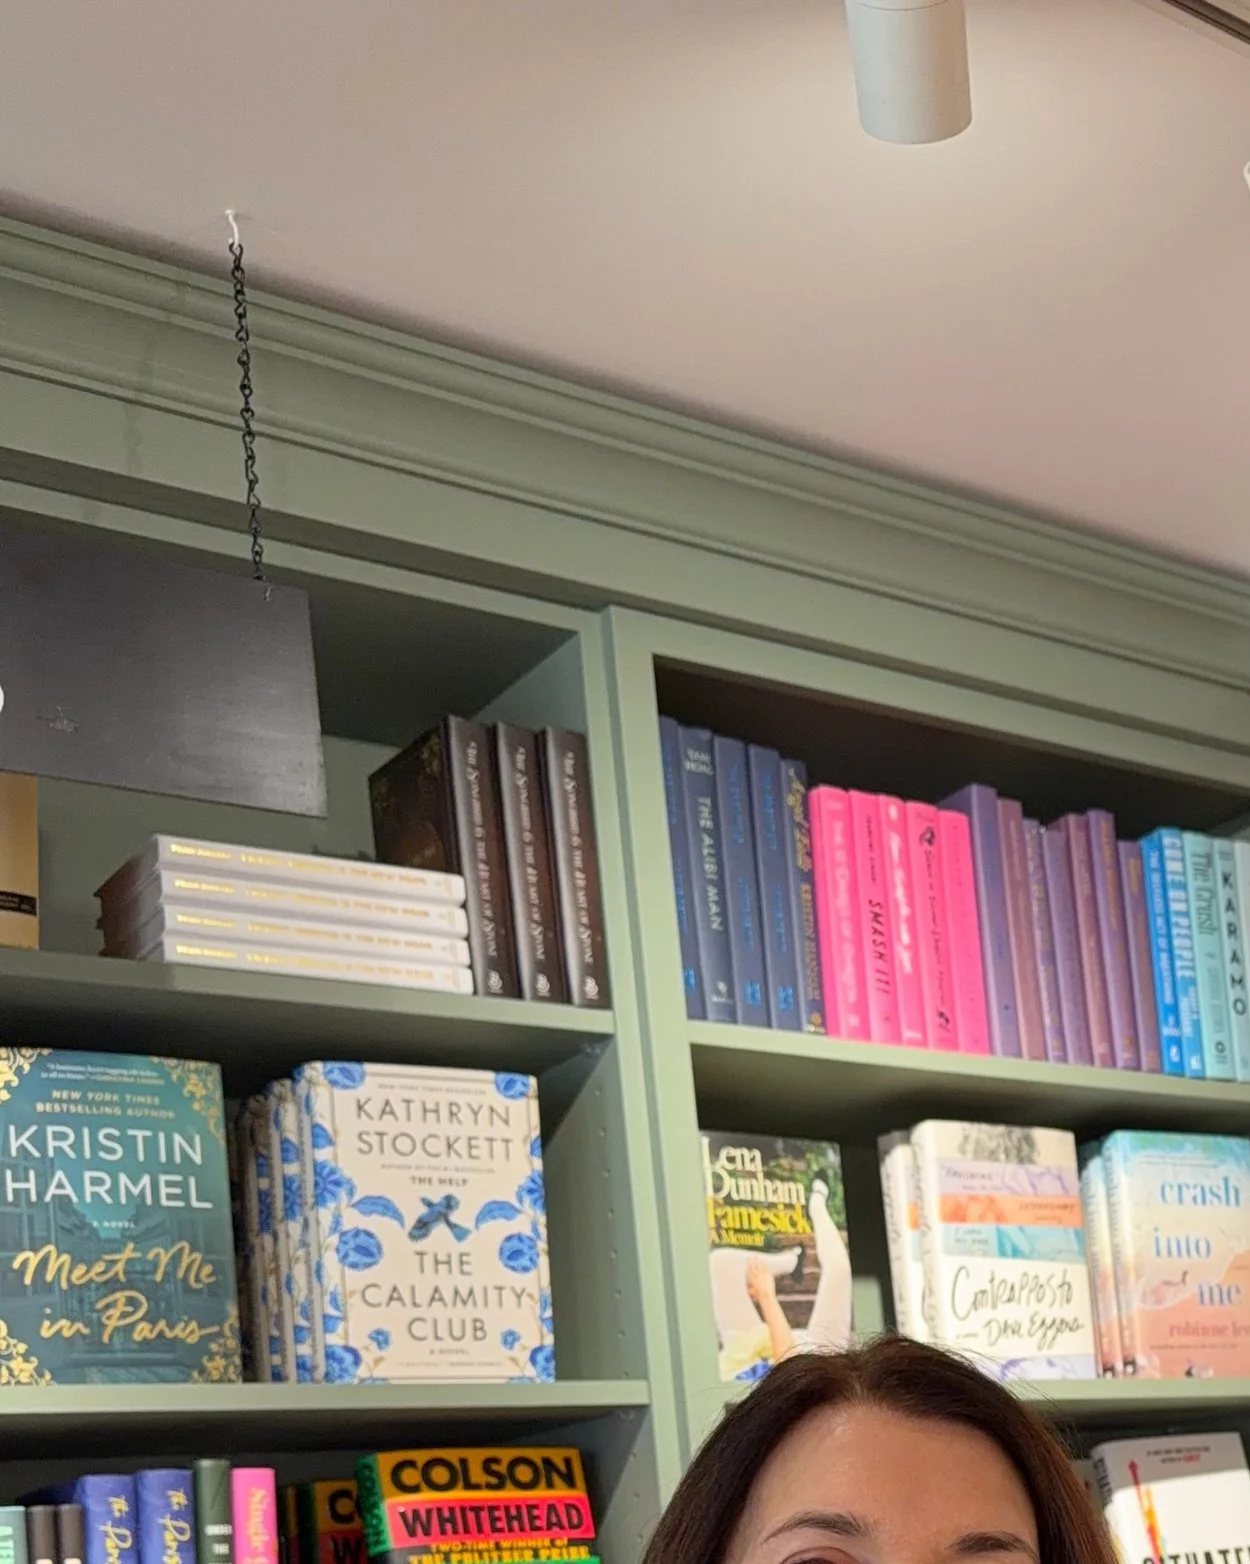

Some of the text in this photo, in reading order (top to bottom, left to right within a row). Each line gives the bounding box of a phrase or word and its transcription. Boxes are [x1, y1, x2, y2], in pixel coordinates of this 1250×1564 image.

[697, 795, 724, 931] THE ALIBI MAN
[1192, 853, 1212, 882] The
[1195, 887, 1219, 935] Crush
[869, 900, 888, 961] SMASH
[1221, 872, 1247, 1016] KARAMO
[1170, 917, 1194, 978] PEOPLE
[874, 969, 891, 996] IT!
[36, 1102, 175, 1119] BESTSELLING AUTHOR
[52, 1089, 160, 1105] NEW YORK TIMES
[356, 1098, 511, 1127] KATHRYN
[8, 1125, 203, 1165] KRISTIN
[357, 1131, 514, 1162] STOCKETT
[700, 1136, 763, 1172] Lena
[5, 1169, 213, 1209] HARMEL
[410, 1177, 469, 1188] THE HELP
[706, 1165, 806, 1206] Dunham
[1159, 1176, 1241, 1208] crash
[103, 1221, 136, 1229] NOVEL
[1152, 1228, 1212, 1261] into
[12, 1241, 217, 1290] Meet Me
[414, 1251, 472, 1276] THE
[361, 1283, 528, 1309] CALAMITY
[1197, 1282, 1242, 1307] me
[40, 1290, 220, 1344] in Paris
[407, 1317, 488, 1342] CLUB
[390, 1457, 577, 1493] COLSON
[248, 1488, 269, 1551] Single
[399, 1503, 584, 1538] WHITEHEAD
[431, 1538, 553, 1553] TWO-TIME WINNER
[541, 1545, 591, 1561] PRIZE
